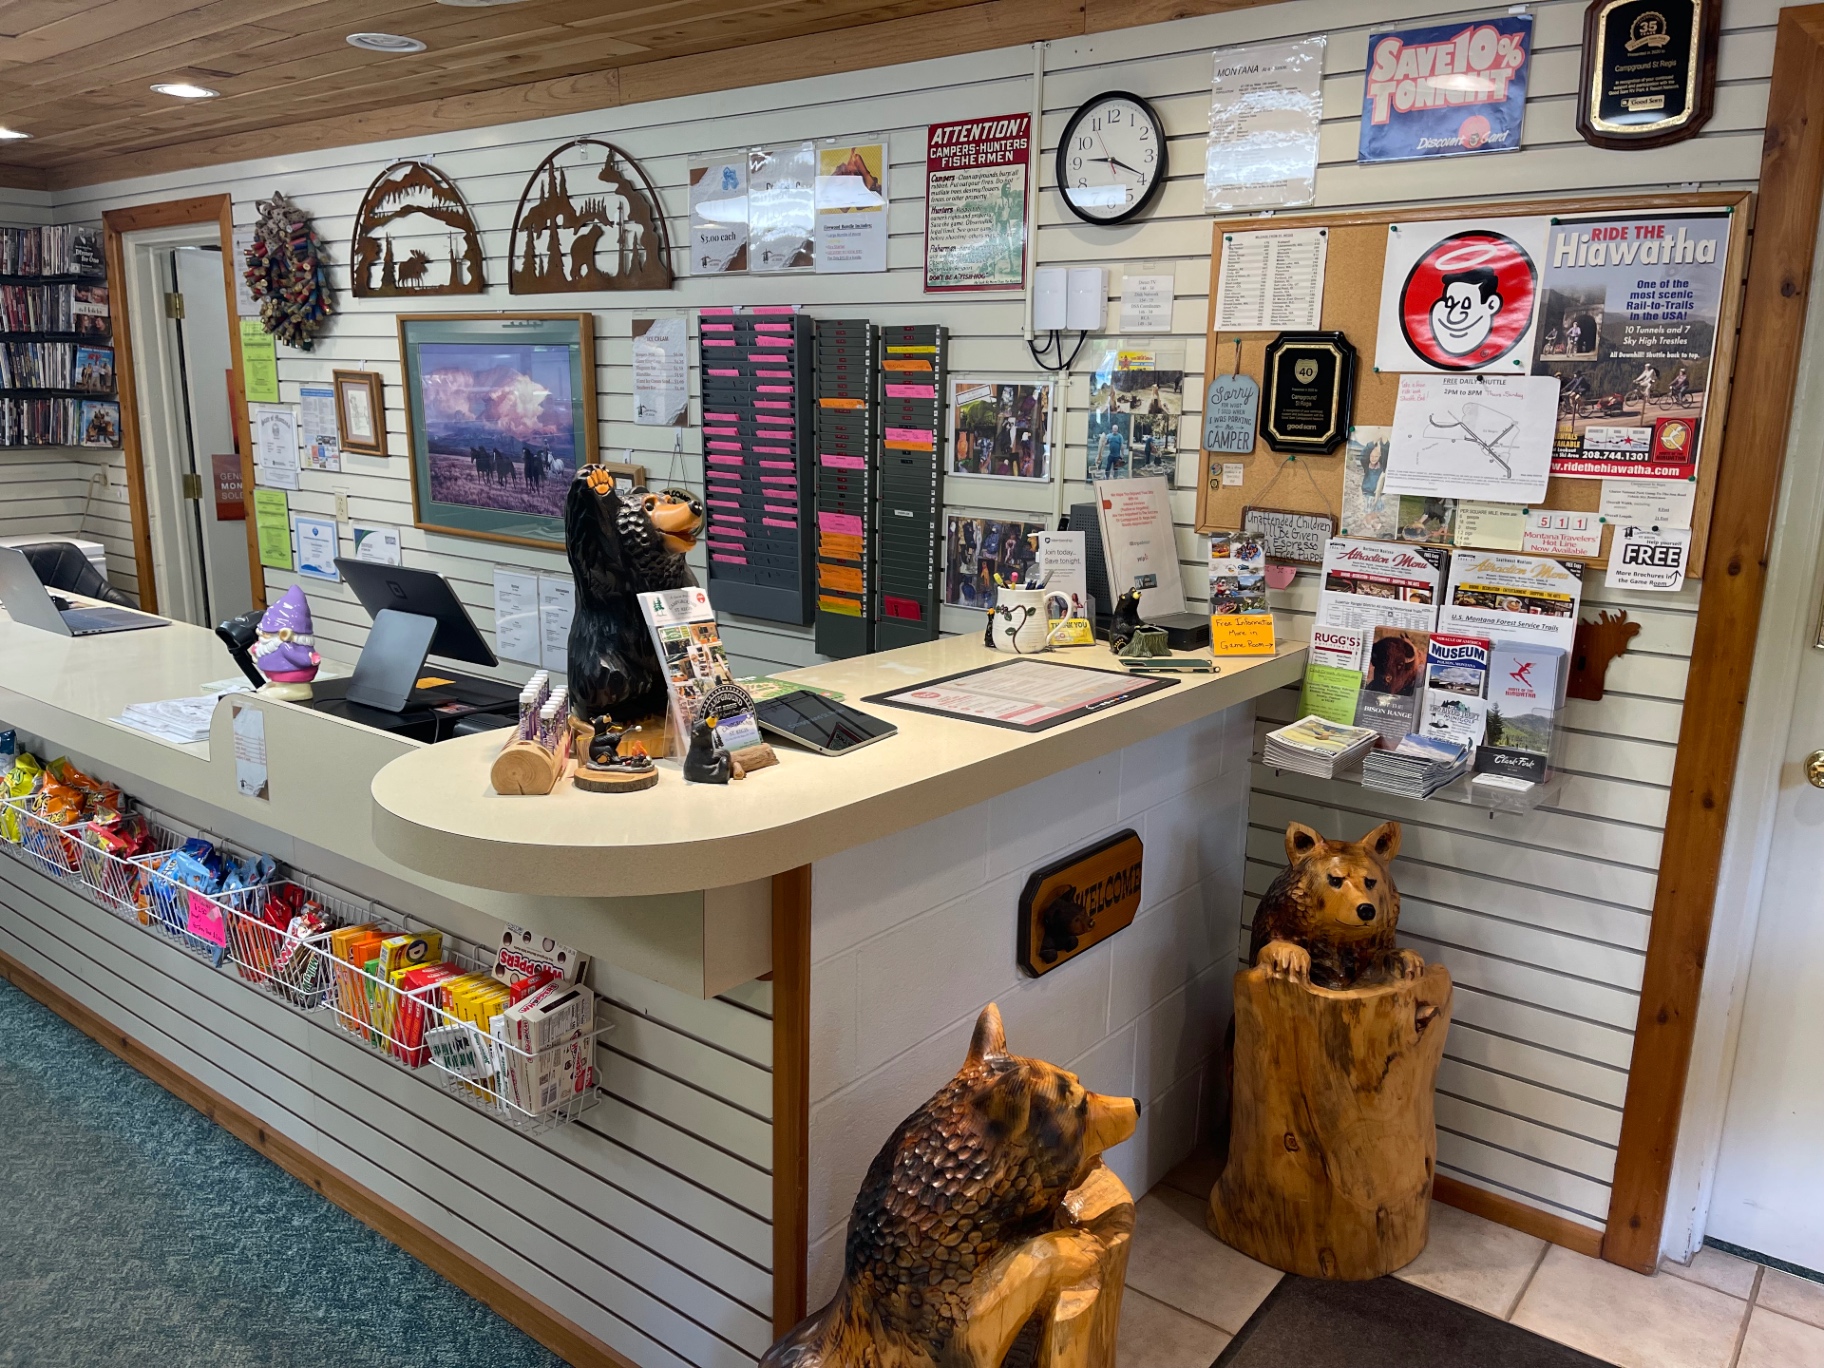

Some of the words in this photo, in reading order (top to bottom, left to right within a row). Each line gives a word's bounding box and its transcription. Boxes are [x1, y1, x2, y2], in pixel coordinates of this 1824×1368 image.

[1639, 21, 1658, 32] 35
[1369, 36, 1456, 83] SAVE
[1451, 25, 1526, 72] 10%
[1216, 65, 1259, 77] MONTANA
[1614, 62, 1651, 72] Campground
[1107, 109, 1120, 124] 12
[1130, 114, 1134, 127] 1
[931, 117, 1028, 146] ATTENTION!
[1092, 118, 1102, 132] 11
[1140, 126, 1149, 140] 2
[1416, 136, 1466, 150] Discount
[1481, 130, 1510, 143] Card
[930, 138, 1028, 158] CAMPERS-HUNTERS
[1078, 136, 1093, 150] 10
[941, 151, 1014, 168] FISHERMEN
[1144, 148, 1154, 164] 3
[1072, 157, 1082, 170] 9
[931, 174, 956, 183] Campers
[1136, 172, 1148, 186] 4
[1126, 188, 1134, 202] 5
[931, 206, 954, 214] Hunters
[1591, 226, 1630, 242] RIDE
[1634, 225, 1666, 240] THE
[1553, 227, 1718, 268] Hiawatha
[1637, 280, 1656, 289] One
[1659, 280, 1670, 288] of
[1672, 279, 1689, 288] the
[1630, 290, 1656, 300] most
[1658, 290, 1694, 300] scenic
[1626, 301, 1694, 310] Rail-to-Trails
[1630, 312, 1640, 320] in
[1642, 312, 1660, 321] the
[1662, 312, 1688, 321] USA!
[1624, 326, 1634, 334] 10
[1636, 326, 1665, 334] Tunnels
[1666, 326, 1682, 334] and
[1685, 326, 1692, 334] 7
[1623, 336, 1636, 346] Sky
[1638, 336, 1657, 346] High
[1659, 336, 1688, 345] Trestles
[1299, 368, 1314, 376] 40
[1442, 378, 1458, 386] FREE
[1211, 386, 1254, 405] Sorry
[1228, 417, 1252, 426] PARKING
[1208, 430, 1250, 450] CAMPER
[1582, 450, 1648, 461] 208.744.1301
[1248, 512, 1294, 528] Unattended
[1296, 516, 1330, 533] Children
[1541, 516, 1548, 528] 5
[1560, 518, 1564, 528] 1
[1578, 519, 1582, 528] 1
[1278, 526, 1290, 540] Be
[1291, 528, 1319, 542] Given
[1524, 532, 1560, 540] Montana
[1560, 534, 1598, 542] Travelers'
[1272, 538, 1318, 550] Espresso
[1551, 546, 1588, 555] Available
[1273, 547, 1295, 558] Free
[1336, 547, 1390, 564] Attraction
[1392, 554, 1428, 569] Menu
[1623, 544, 1682, 568] FREE
[1060, 558, 1082, 566] tonight.
[1465, 558, 1528, 575] Attraction
[1530, 563, 1570, 580] Menu
[1633, 571, 1664, 579] Brochures
[1216, 618, 1232, 626] Free
[1235, 618, 1272, 626] Information
[1466, 615, 1494, 624] Montana
[1496, 618, 1517, 626] Forest
[1518, 621, 1541, 629] Service
[1542, 624, 1559, 632] Trails
[1220, 641, 1245, 650] Game
[1248, 640, 1264, 648] Room
[1314, 632, 1356, 647] RUGG'S
[1432, 642, 1486, 660] MUSEUM
[1364, 705, 1386, 714] BISON
[1386, 709, 1413, 719] RANGE
[1075, 862, 1142, 917] WELCOME
[518, 982, 560, 1014] WHOPPERS
